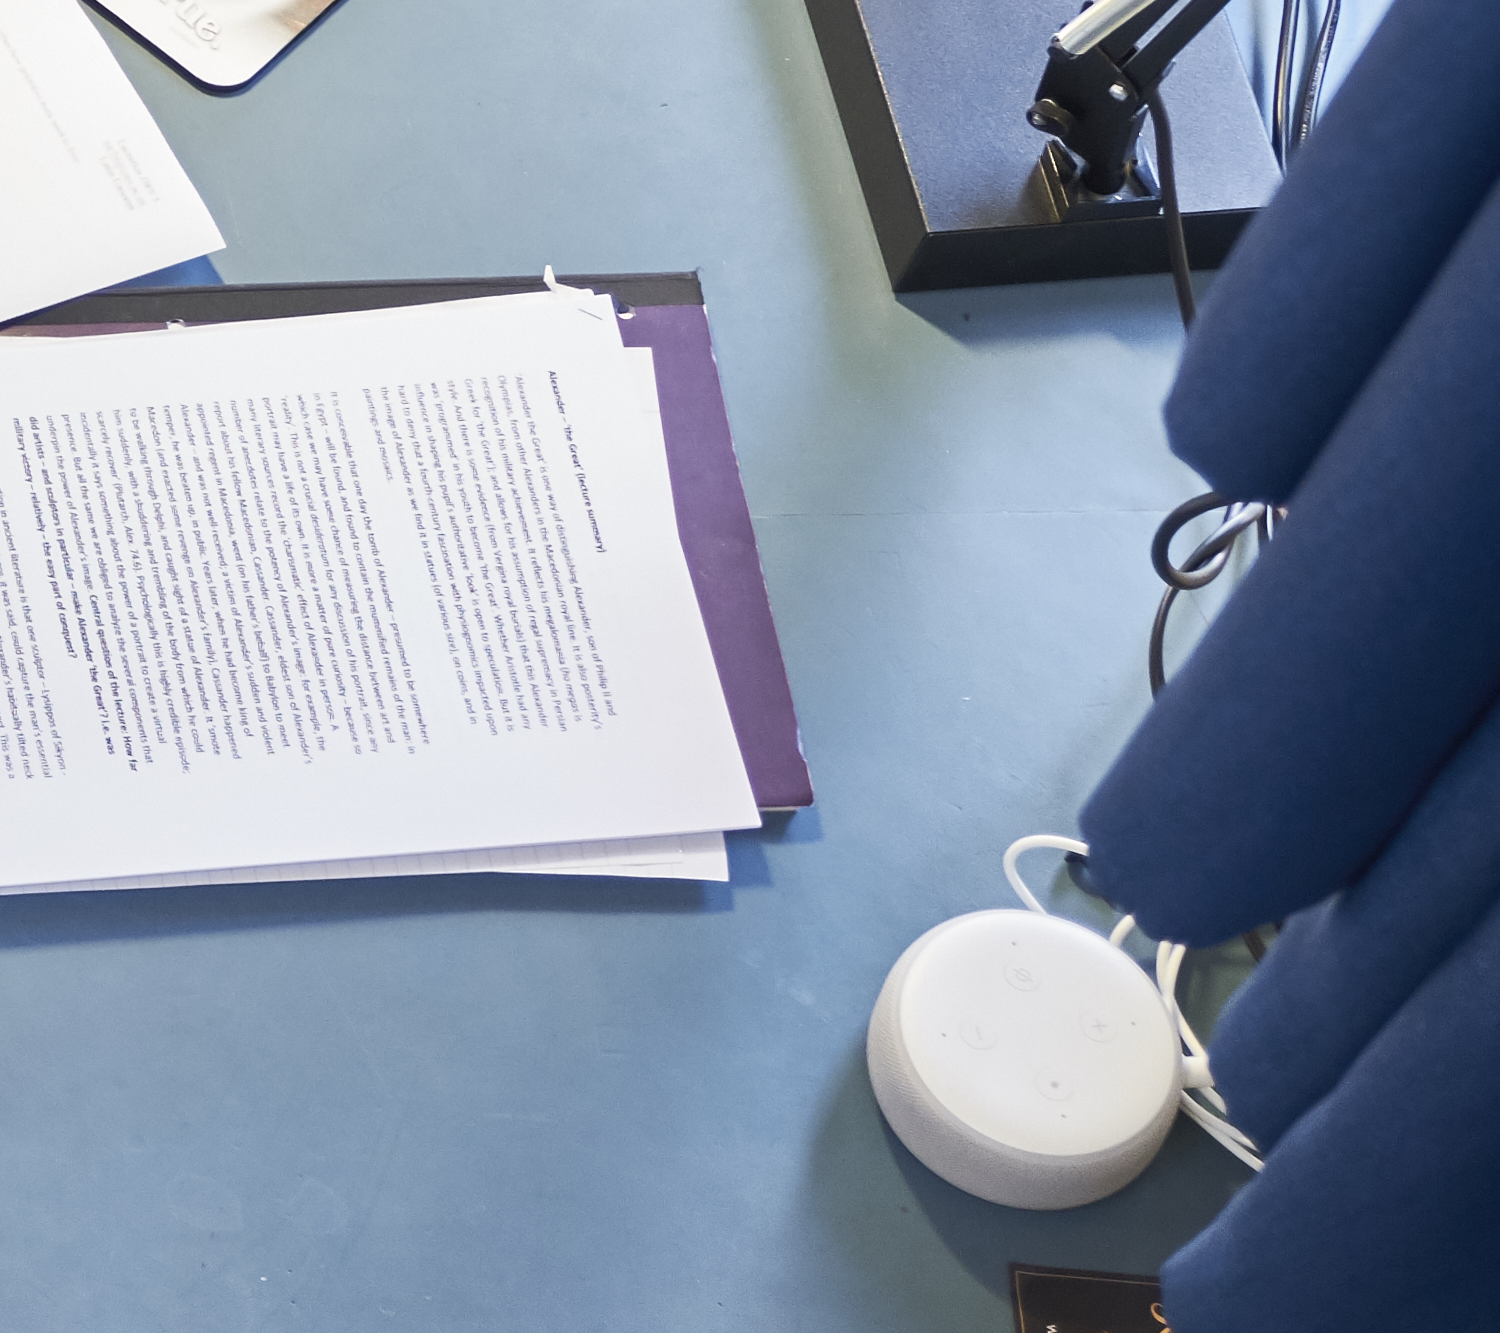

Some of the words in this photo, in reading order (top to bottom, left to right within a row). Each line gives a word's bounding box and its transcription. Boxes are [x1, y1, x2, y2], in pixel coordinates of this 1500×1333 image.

[547, 369, 566, 415] Alexander
[28, 415, 40, 430] did
[526, 420, 537, 436] the
[32, 431, 45, 459] artists
[40, 467, 53, 485] and
[539, 465, 548, 473] is
[540, 474, 552, 492] one
[44, 486, 60, 526] sculptors
[546, 493, 557, 511] way
[551, 512, 564, 522] of
[55, 527, 64, 537] in
[55, 538, 74, 580] particular
[555, 523, 578, 584] distinguishing
[69, 590, 82, 615] make
[88, 593, 105, 627] Central
[76, 616, 94, 663] Alexander
[95, 628, 112, 668] question
[585, 634, 597, 651] son
[590, 652, 603, 663] of
[106, 669, 118, 680] of
[595, 663, 608, 689] Philip
[109, 680, 120, 697] the
[603, 698, 618, 716] and
[104, 735, 115, 755] was
[122, 735, 133, 757] How
[127, 758, 138, 772] far
